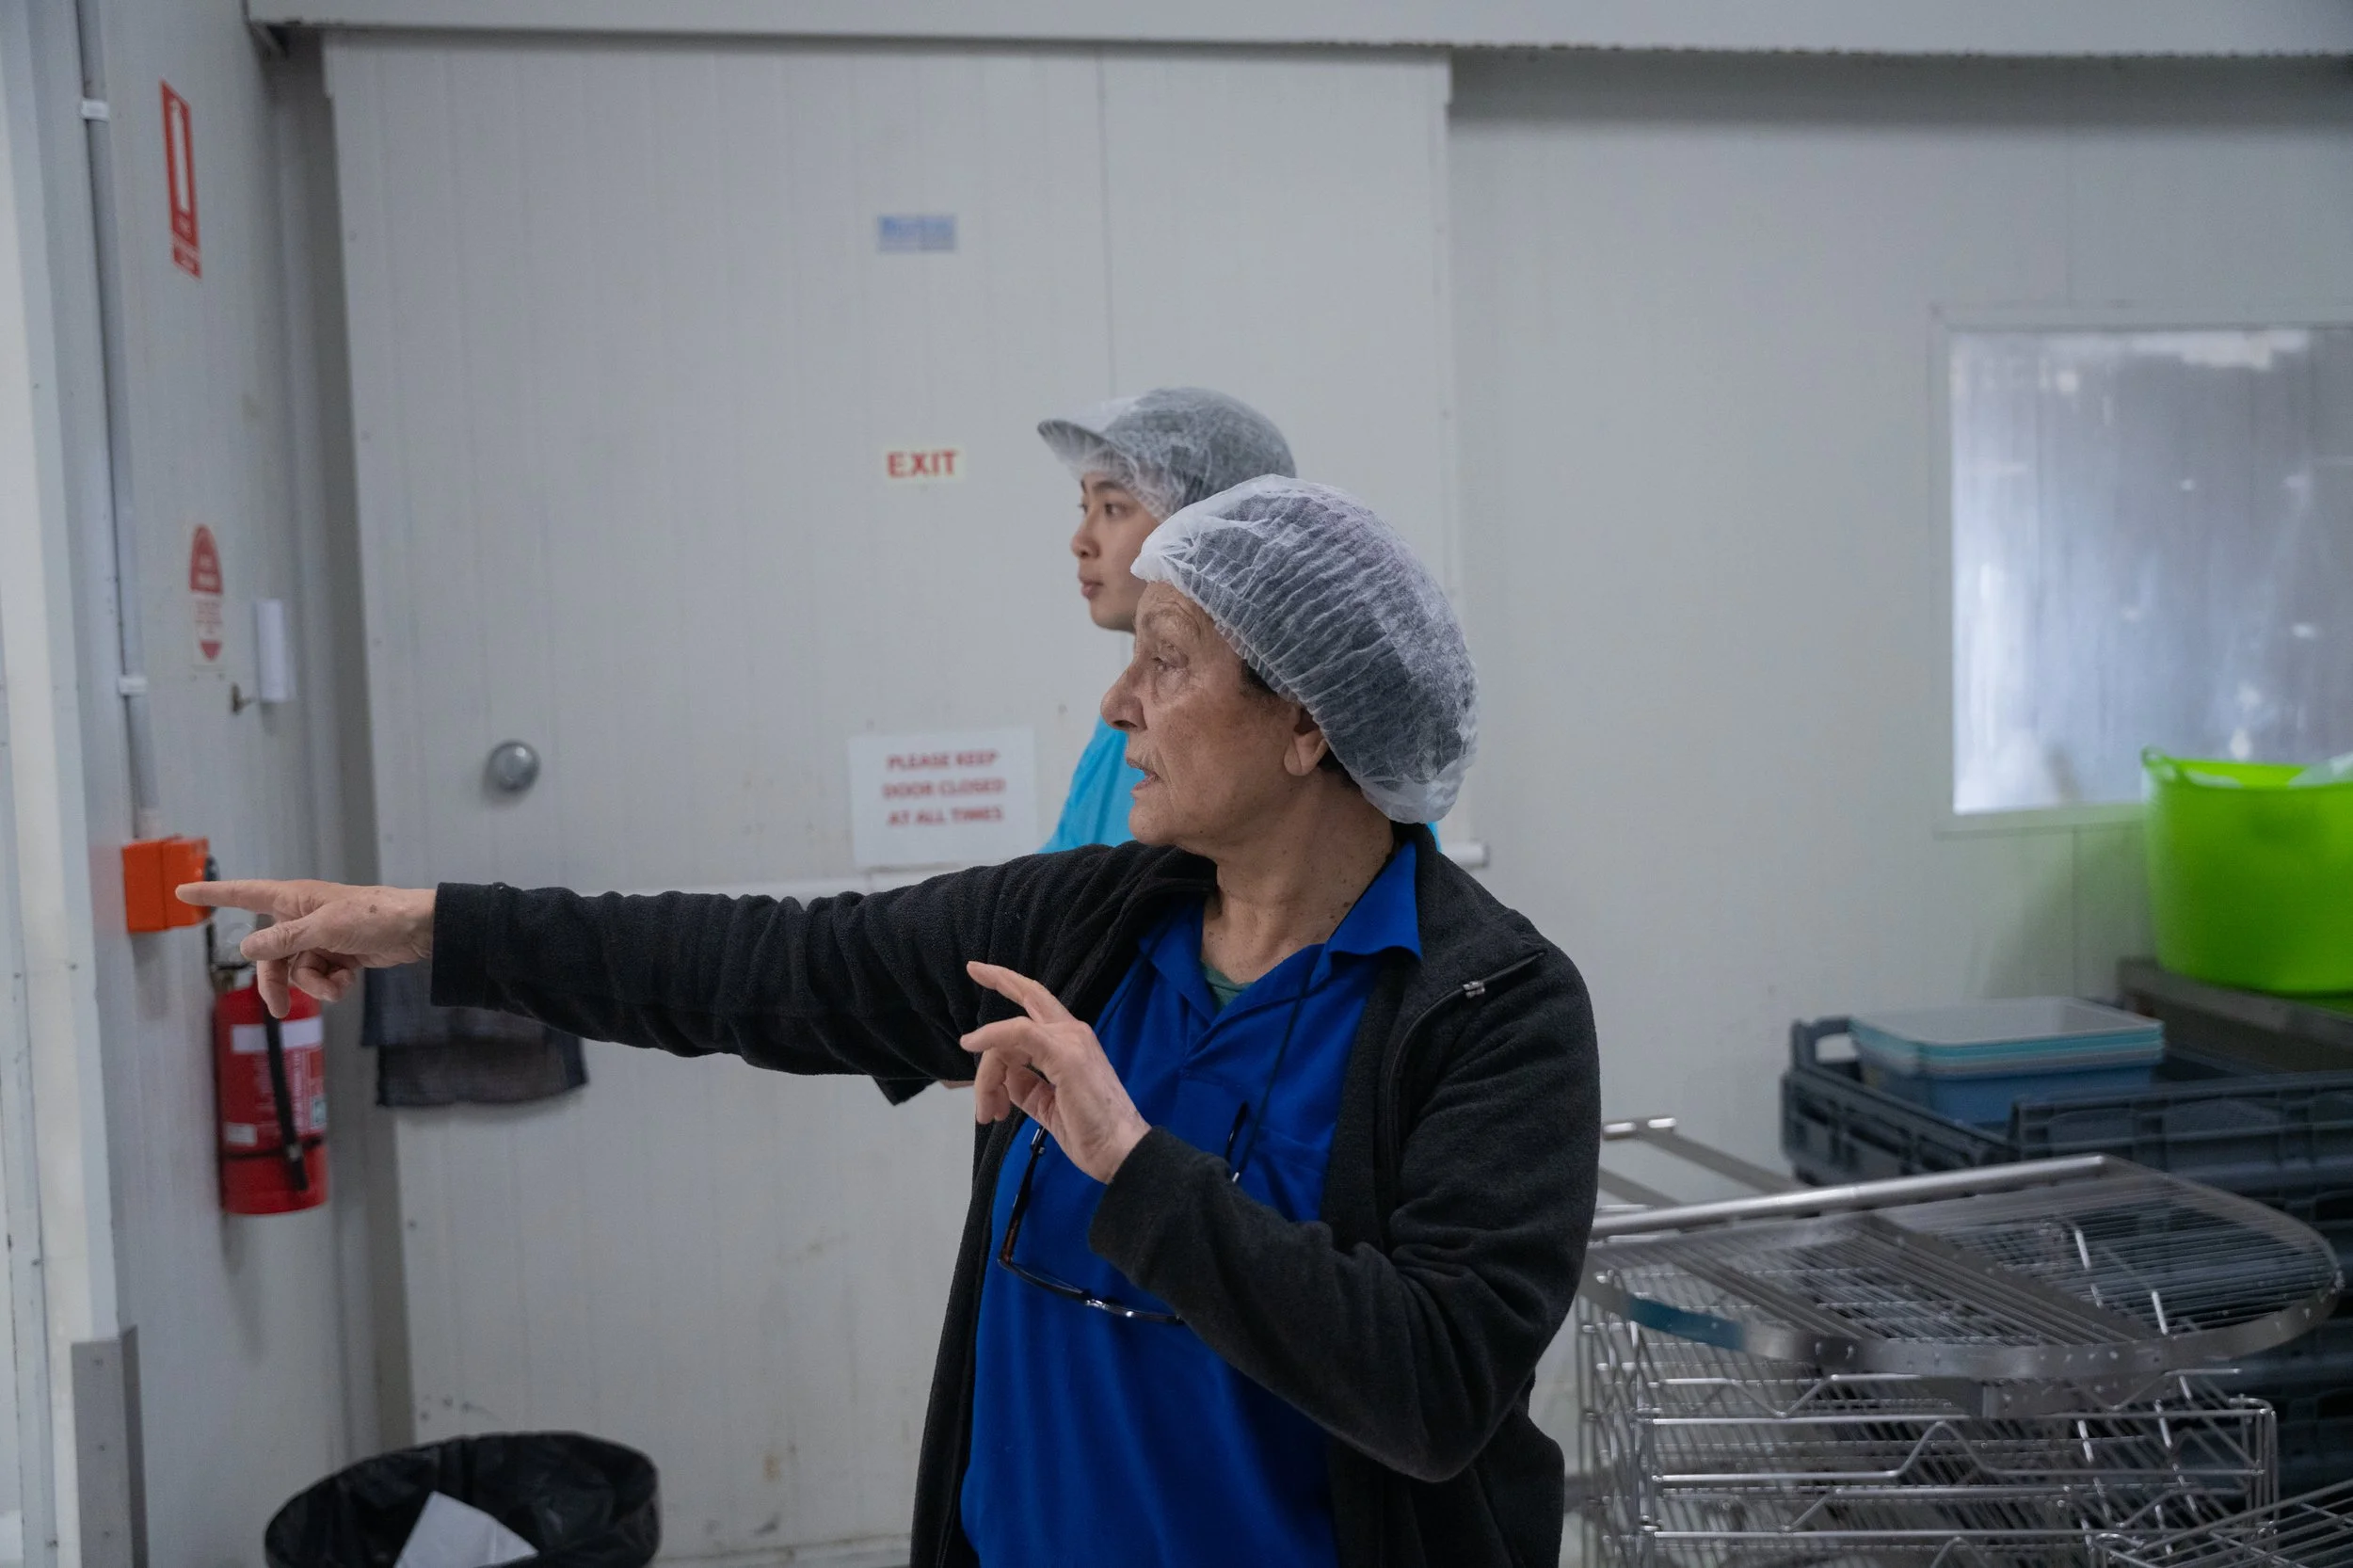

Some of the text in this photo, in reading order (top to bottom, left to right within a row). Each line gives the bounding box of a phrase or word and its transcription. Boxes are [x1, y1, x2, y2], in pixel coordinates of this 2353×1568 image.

[888, 450, 957, 477] EXIT
[887, 750, 998, 770] PLEASE KEEP
[882, 778, 1005, 798] DOOR CLOSED
[888, 806, 1003, 826] AT ALL TIMES
